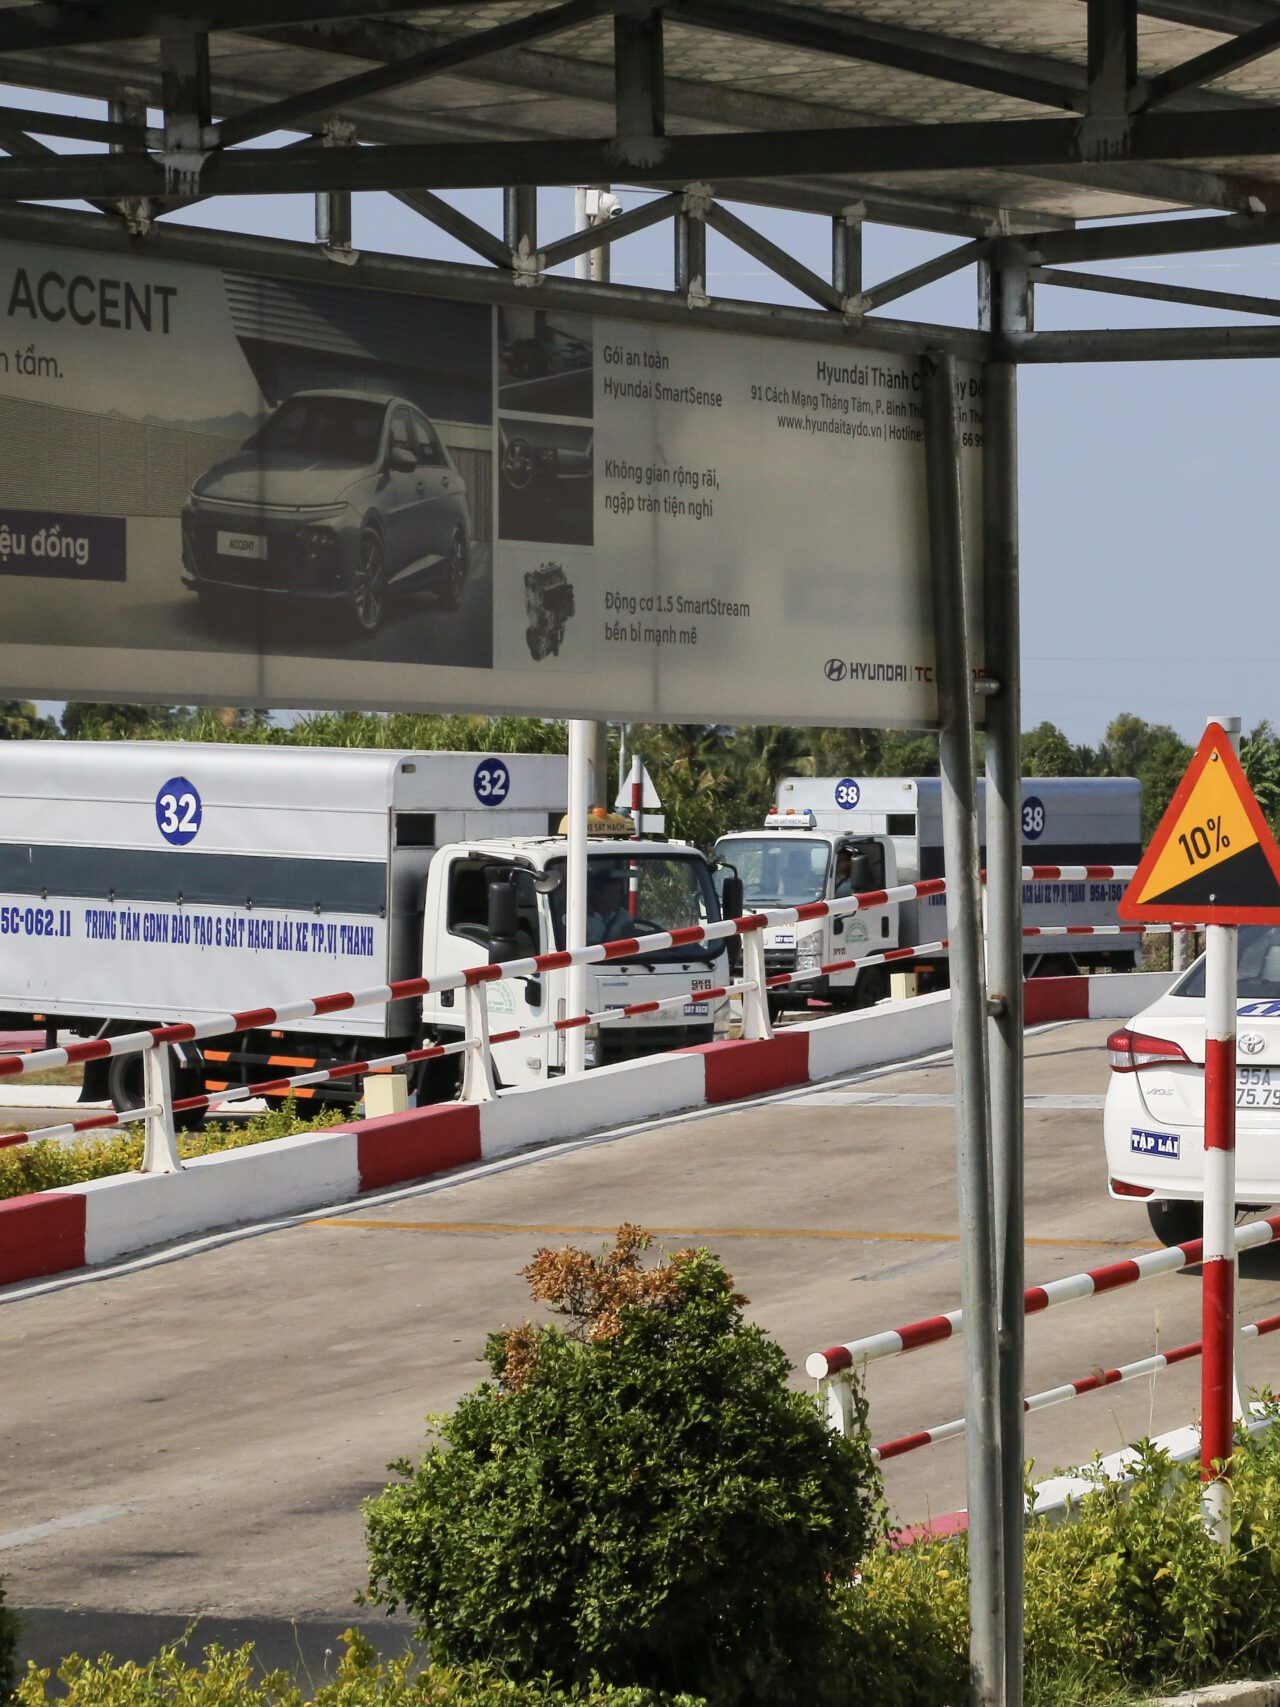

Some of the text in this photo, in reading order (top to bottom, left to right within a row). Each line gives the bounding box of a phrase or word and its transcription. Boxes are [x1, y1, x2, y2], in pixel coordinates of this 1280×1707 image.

[7, 267, 177, 334] ACCENT
[14, 344, 64, 378] tầm.
[603, 345, 669, 369] Gói an toàn
[816, 360, 869, 386] Hyundai
[871, 367, 909, 391] Thành
[603, 377, 723, 407] Hyundai SmartSense
[751, 385, 762, 401] 91
[765, 386, 789, 405] Cách
[792, 389, 818, 411] Mạng
[820, 393, 849, 414] Tháng
[876, 399, 885, 415] P.
[887, 400, 906, 417] Bình
[777, 415, 882, 438] www.hyundaitaydo.vn
[605, 460, 719, 491] Không gian rộng rãi,
[605, 491, 712, 520] ngập tràn tiện nghi
[0, 523, 89, 566] ệu đồng
[605, 591, 750, 617] Động cơ 1.5 SmartStream
[644, 624, 677, 647] mạnh
[680, 626, 698, 645] mẽ
[850, 662, 907, 682] HYUNDAI
[477, 769, 506, 796] 32
[837, 785, 858, 804] 38
[160, 793, 198, 834] 32
[1022, 806, 1043, 832] 38
[1178, 815, 1231, 866] 10%
[0, 907, 71, 938] 5C-062.11
[85, 909, 116, 941] TRUNG
[119, 906, 140, 942] TÂM
[143, 912, 169, 944] GDNN
[171, 908, 191, 945] ĐÀO
[193, 915, 212, 952] TẠO
[215, 916, 222, 947] &
[225, 911, 245, 948] SÁT
[248, 918, 274, 954] HẠCH
[277, 914, 293, 951] LÁI
[295, 921, 308, 952] XE
[340, 924, 374, 957] THANH
[1239, 1068, 1271, 1086] 95A
[1131, 1132, 1179, 1154] TẬP LÁI
